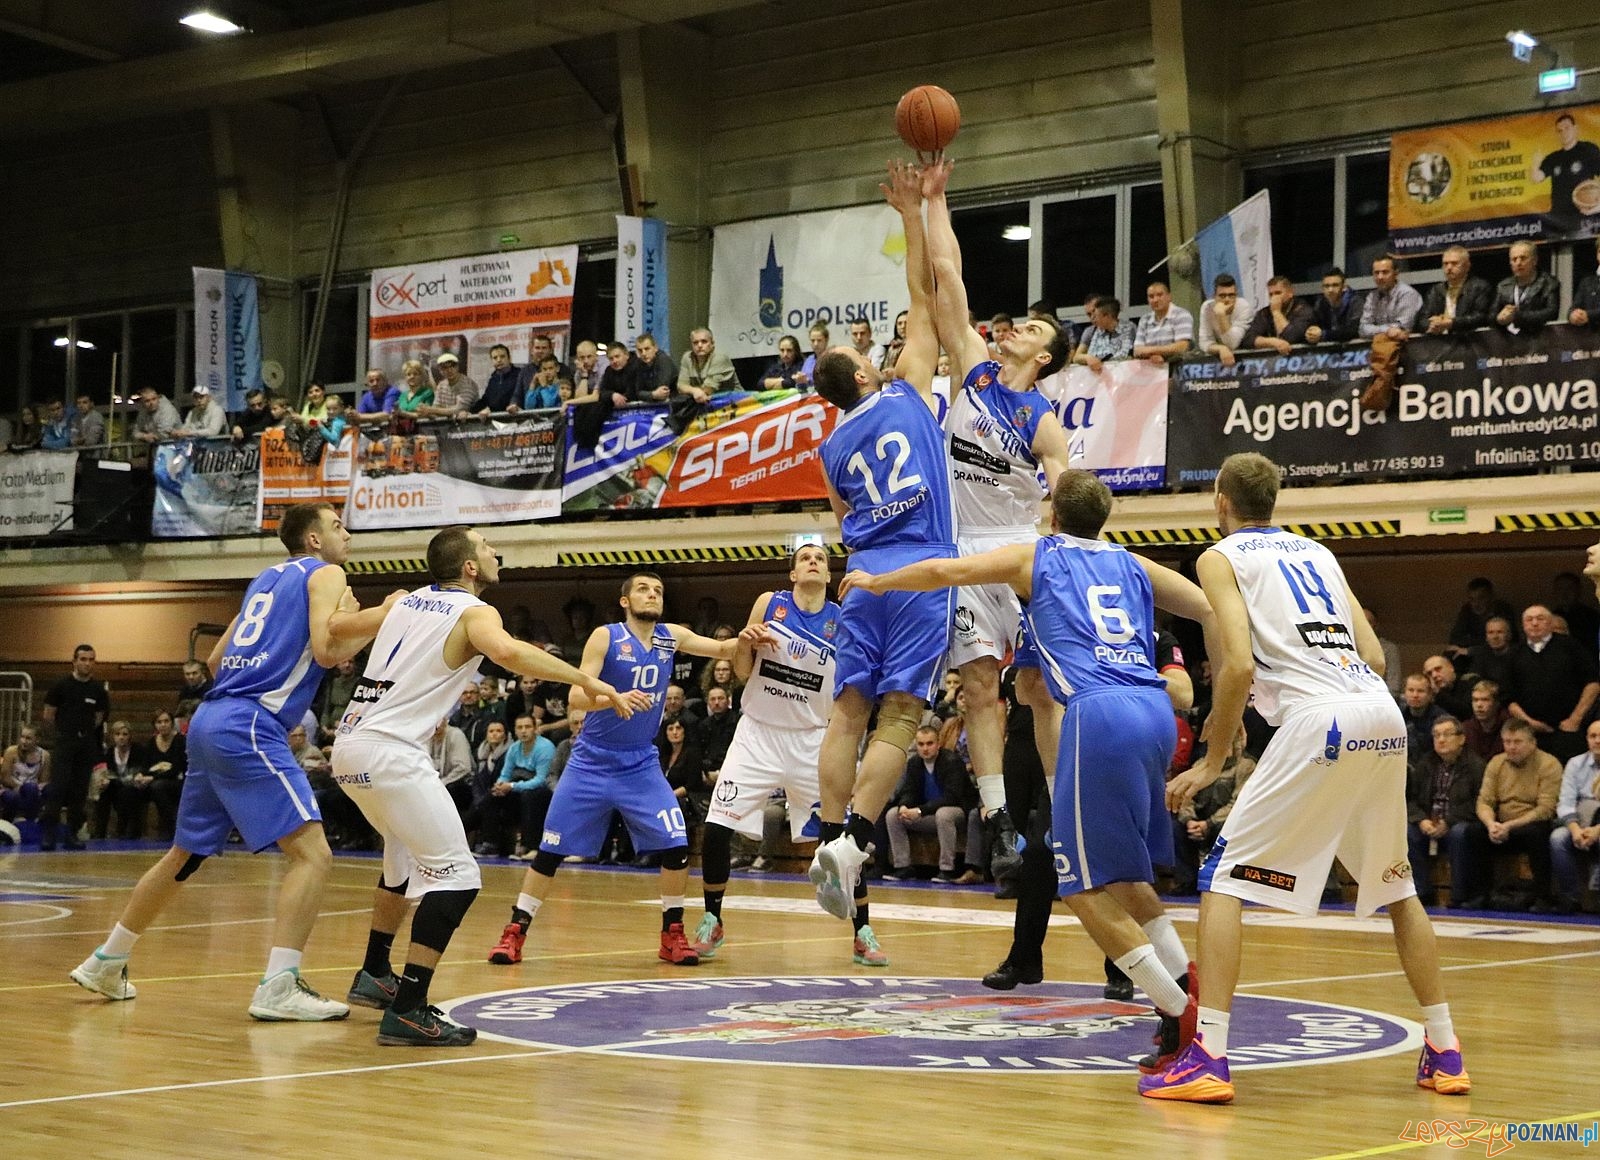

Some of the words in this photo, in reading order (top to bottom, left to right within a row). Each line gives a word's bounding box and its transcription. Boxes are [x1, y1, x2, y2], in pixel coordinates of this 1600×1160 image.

[1394, 219, 1543, 248] www.pwsz.raciborz.edu.pl
[460, 261, 511, 275] HURTOWNIA
[453, 287, 516, 304] BUDOWLANYCH
[373, 319, 421, 333] ZAPRASZAMY
[787, 300, 889, 330] OPOLSKIE
[233, 293, 248, 391] PRUDNIK
[1273, 349, 1371, 373] POŻYCZK
[1222, 388, 1388, 443] Agencja
[1399, 376, 1600, 423] Bankowa
[1450, 413, 1599, 438] meritumkredyt24.pl
[679, 403, 827, 493] SPOR
[1474, 446, 1541, 467] Infolinia:
[1542, 443, 1574, 462] 801
[729, 467, 767, 490] TEAM
[846, 430, 922, 505] 12
[1179, 468, 1217, 482] PRUDN
[1289, 460, 1339, 478] Szeregów
[1352, 460, 1370, 473] tel.
[1373, 459, 1387, 472] 77
[1388, 456, 1409, 471] 436
[1410, 456, 1427, 469] 90
[1428, 455, 1445, 468] 13
[1277, 558, 1337, 616] 14
[232, 591, 274, 647] 8
[1086, 585, 1136, 645] 6
[817, 646, 830, 666] 9
[631, 664, 659, 689] 10
[763, 685, 809, 704] MORAWIEC
[1346, 736, 1407, 753] OPOLSKIE
[656, 807, 687, 833] 10
[1243, 867, 1295, 889] WA-BET
[546, 977, 942, 999] PRUDNIK
